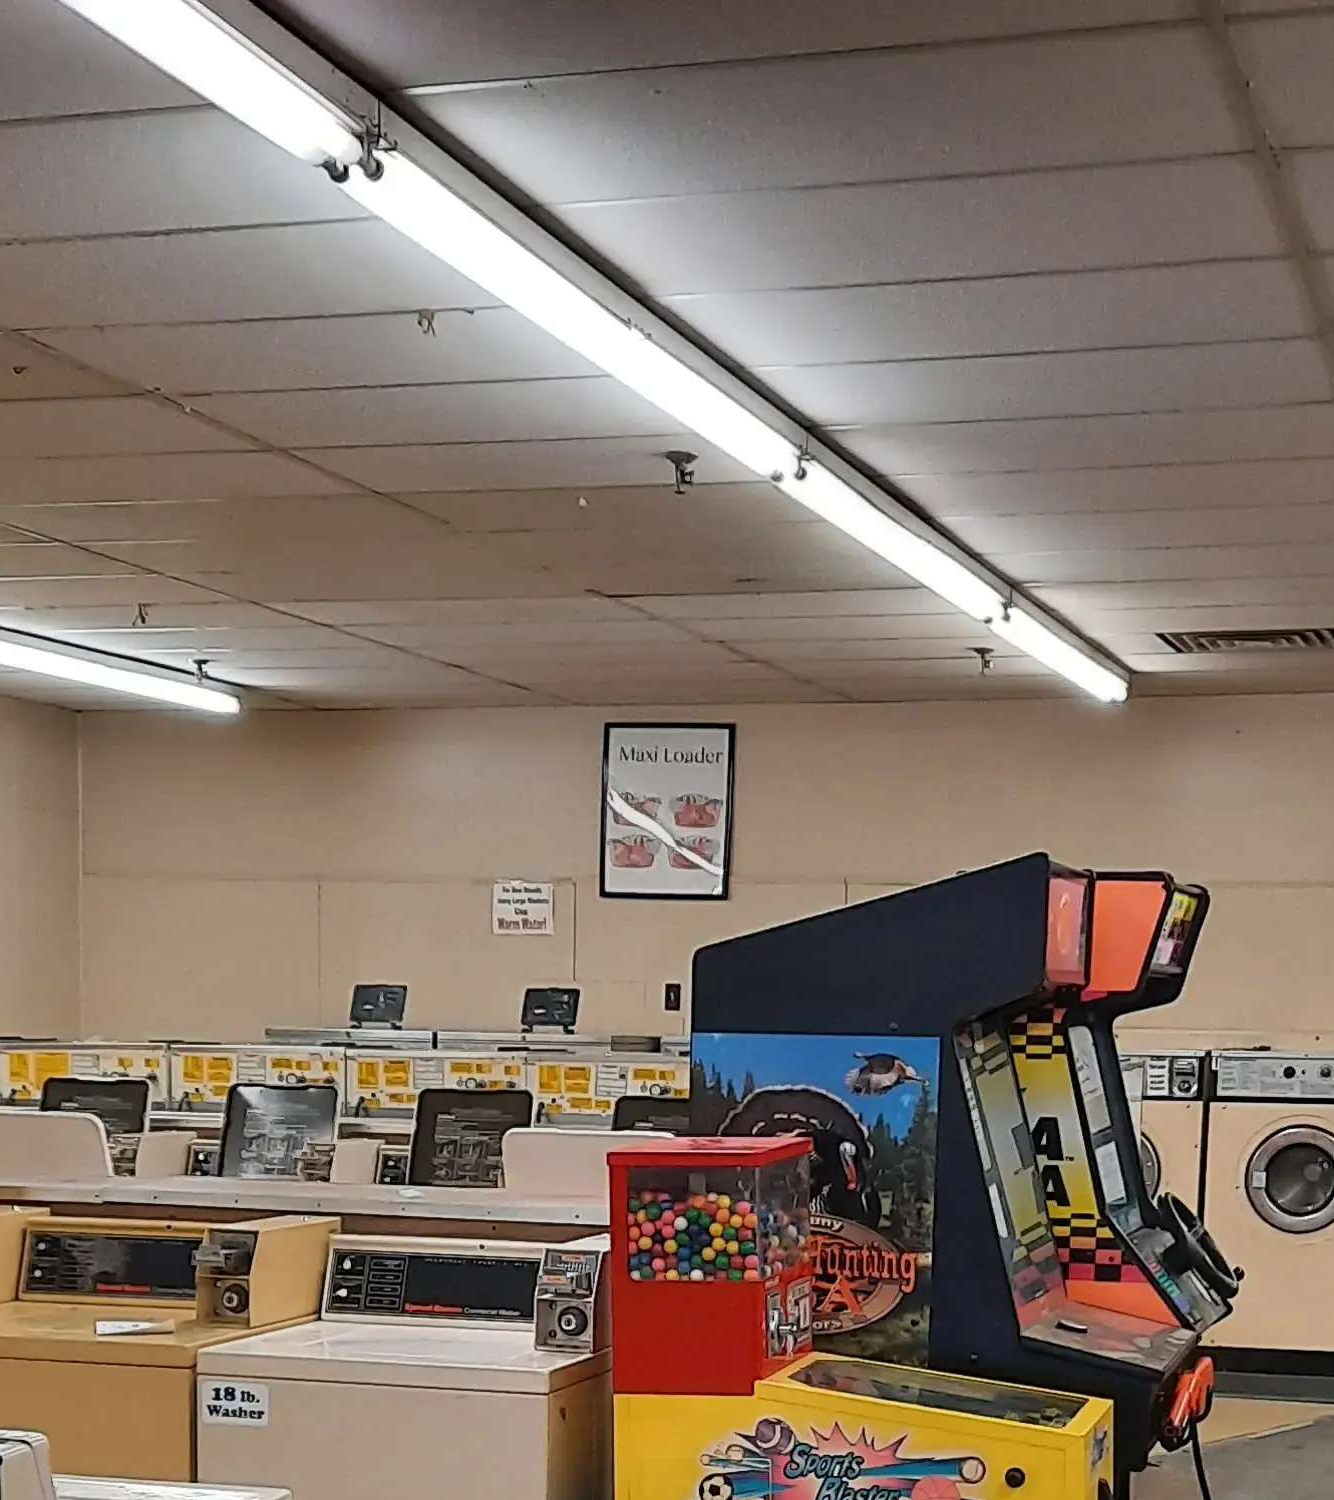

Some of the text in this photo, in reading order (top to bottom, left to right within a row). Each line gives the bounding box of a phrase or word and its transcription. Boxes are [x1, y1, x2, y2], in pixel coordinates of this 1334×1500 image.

[619, 745, 724, 763] Maxi Loader
[211, 1386, 261, 1403] 18 lb.
[206, 1404, 265, 1420] Washer
[783, 1442, 865, 1479] Sports
